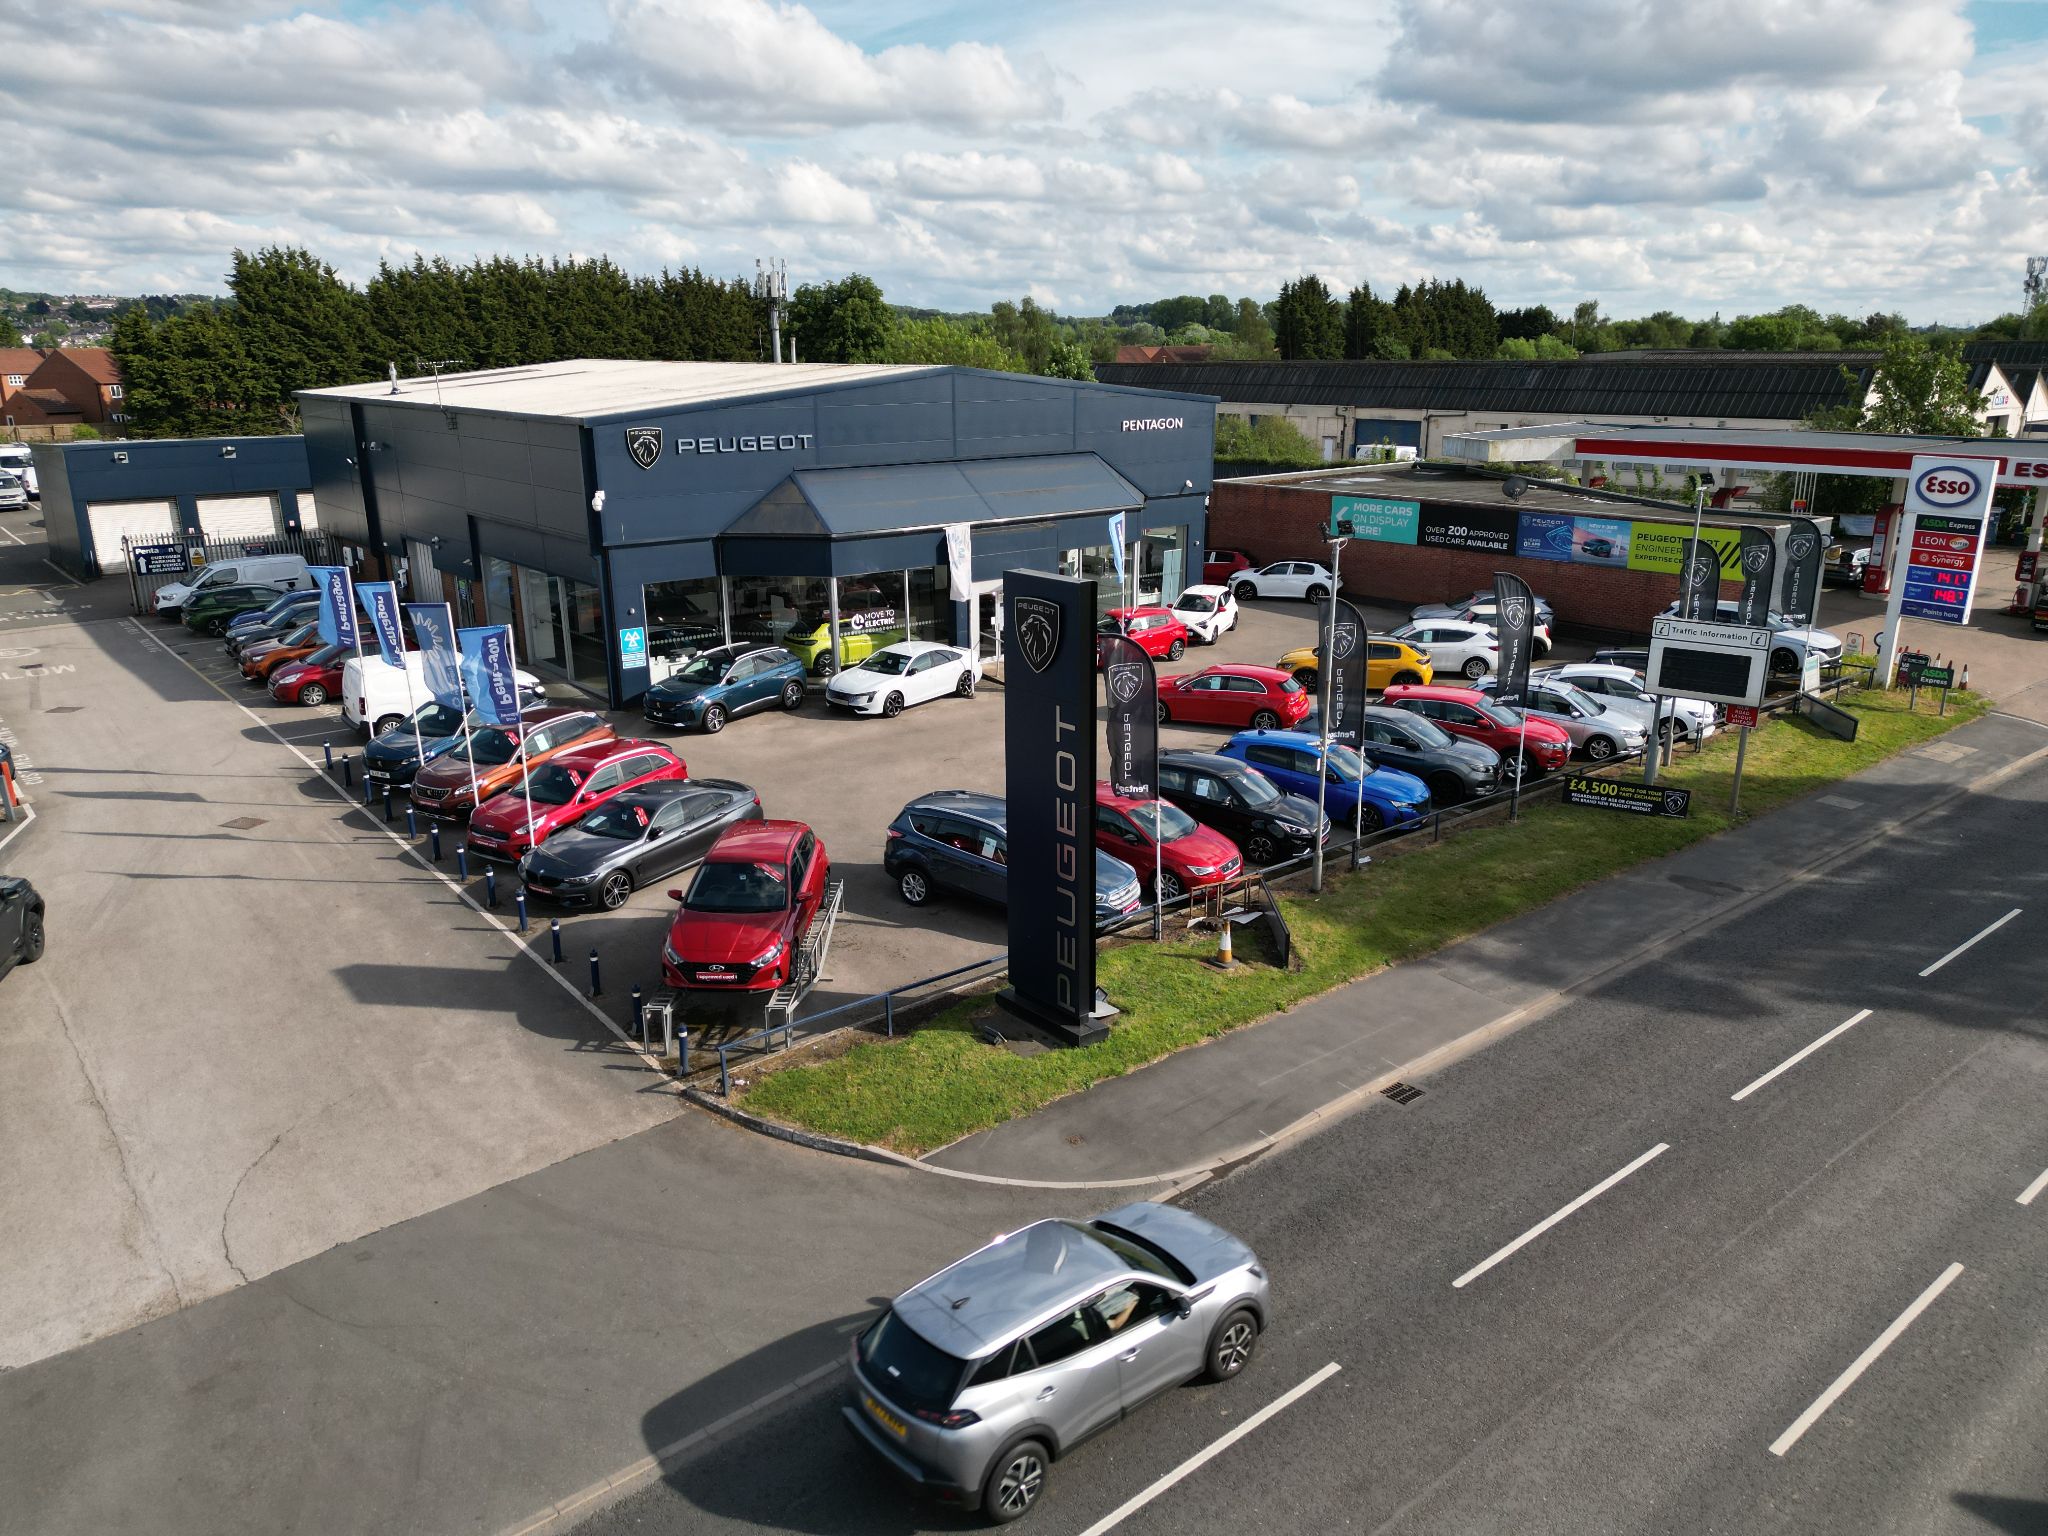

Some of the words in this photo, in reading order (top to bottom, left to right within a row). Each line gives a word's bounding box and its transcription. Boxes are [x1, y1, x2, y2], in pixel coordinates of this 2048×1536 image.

[1121, 417, 1184, 432] PENTAGON
[677, 434, 813, 454] PEUGEOT
[1926, 476, 1970, 495] Esso
[1353, 503, 1382, 513] MORE
[1384, 505, 1413, 516] CARS
[1353, 513, 1367, 523] ON
[1369, 515, 1409, 527] DISPLAY
[1921, 518, 1948, 528] ASDA
[1948, 521, 1976, 530] Express
[1353, 525, 1382, 536] HERE!
[1447, 525, 1468, 536] 200
[1468, 529, 1510, 540] APPROVED
[1425, 534, 1445, 543] USED
[1445, 536, 1465, 546] CARS
[1466, 539, 1508, 550] AVAILABLE
[1637, 533, 1683, 544] PEUGEOT
[1920, 535, 1947, 546] LEON
[135, 547, 174, 555] Pentan
[1635, 543, 1683, 555] ENGINEER
[1634, 553, 1673, 563] EXPERTISE
[1931, 554, 1965, 568] Synergy
[865, 611, 884, 620] MOVE
[1017, 602, 1055, 616] PEUGEOT
[1922, 607, 1943, 617] Points
[1943, 610, 1959, 619] here
[865, 618, 894, 627] ELECTRIC
[1672, 626, 1698, 636] Traffic
[1700, 630, 1748, 641] Information
[0, 664, 77, 681] LOW
[1921, 668, 1949, 679] ASDA
[1920, 676, 1948, 686] Express
[1569, 779, 1618, 796] £4,500
[1571, 792, 1600, 800] REGARDLESS
[1625, 800, 1653, 808] CONDITION
[1056, 705, 1078, 1014] PEUGEOT
